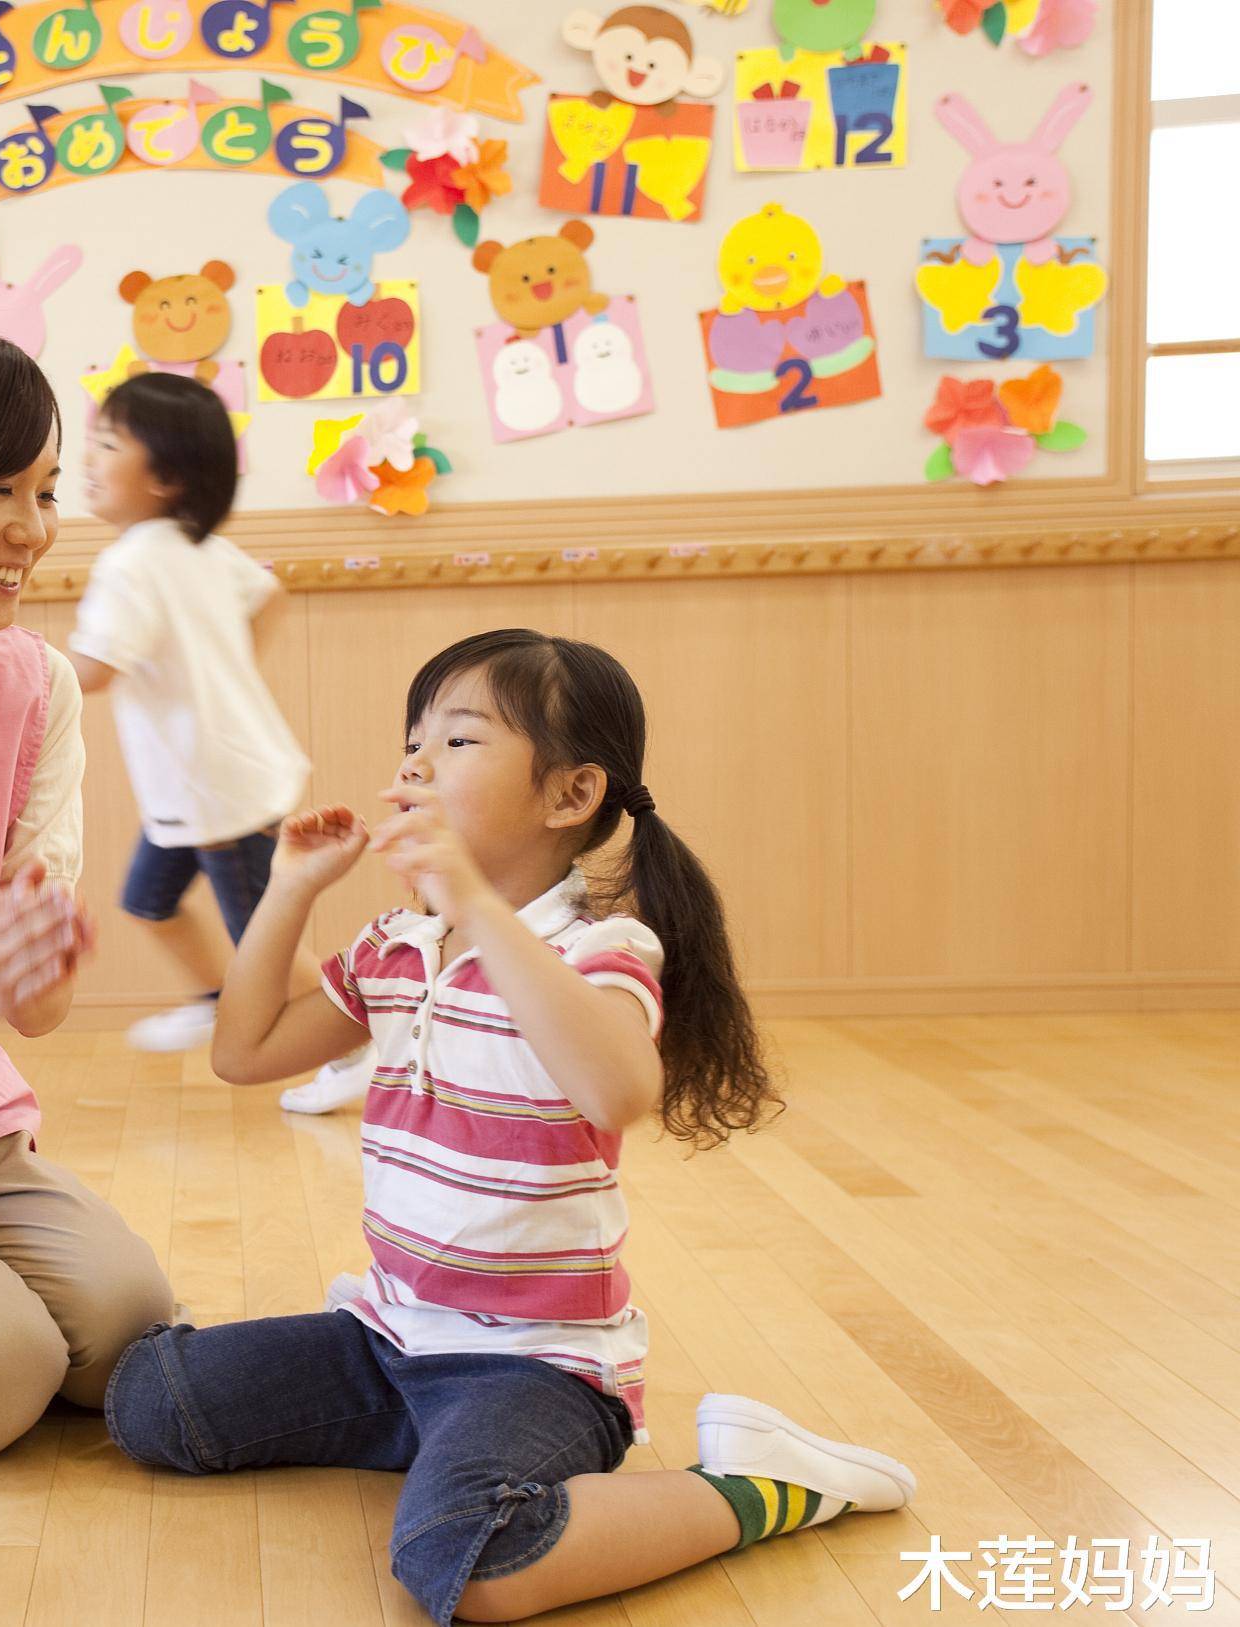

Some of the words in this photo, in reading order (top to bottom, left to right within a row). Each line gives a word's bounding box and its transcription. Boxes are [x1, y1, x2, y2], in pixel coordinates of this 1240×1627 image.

[834, 112, 894, 166] 12
[590, 161, 638, 216] 11
[977, 304, 1021, 360] 3
[350, 340, 408, 395] 10
[774, 357, 819, 414] 2
